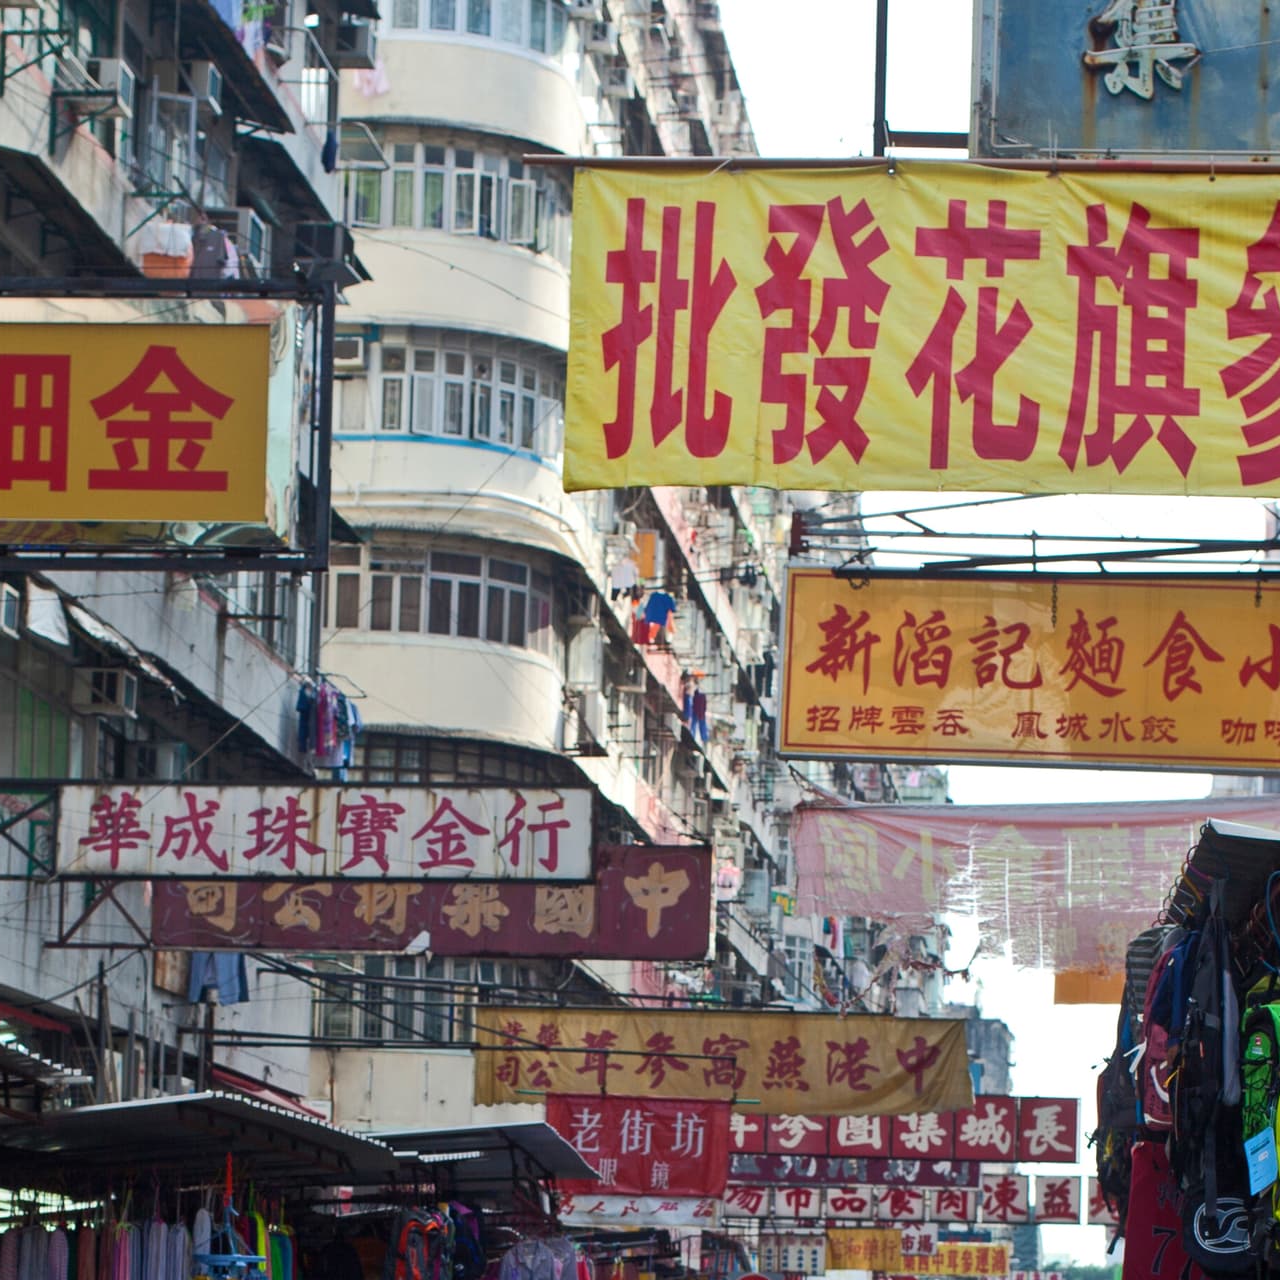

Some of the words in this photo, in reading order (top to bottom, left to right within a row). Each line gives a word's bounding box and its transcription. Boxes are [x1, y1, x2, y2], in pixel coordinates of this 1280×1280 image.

[78, 790, 570, 875] 華成珠寶金行
[570, 1107, 707, 1158] 老街坊
